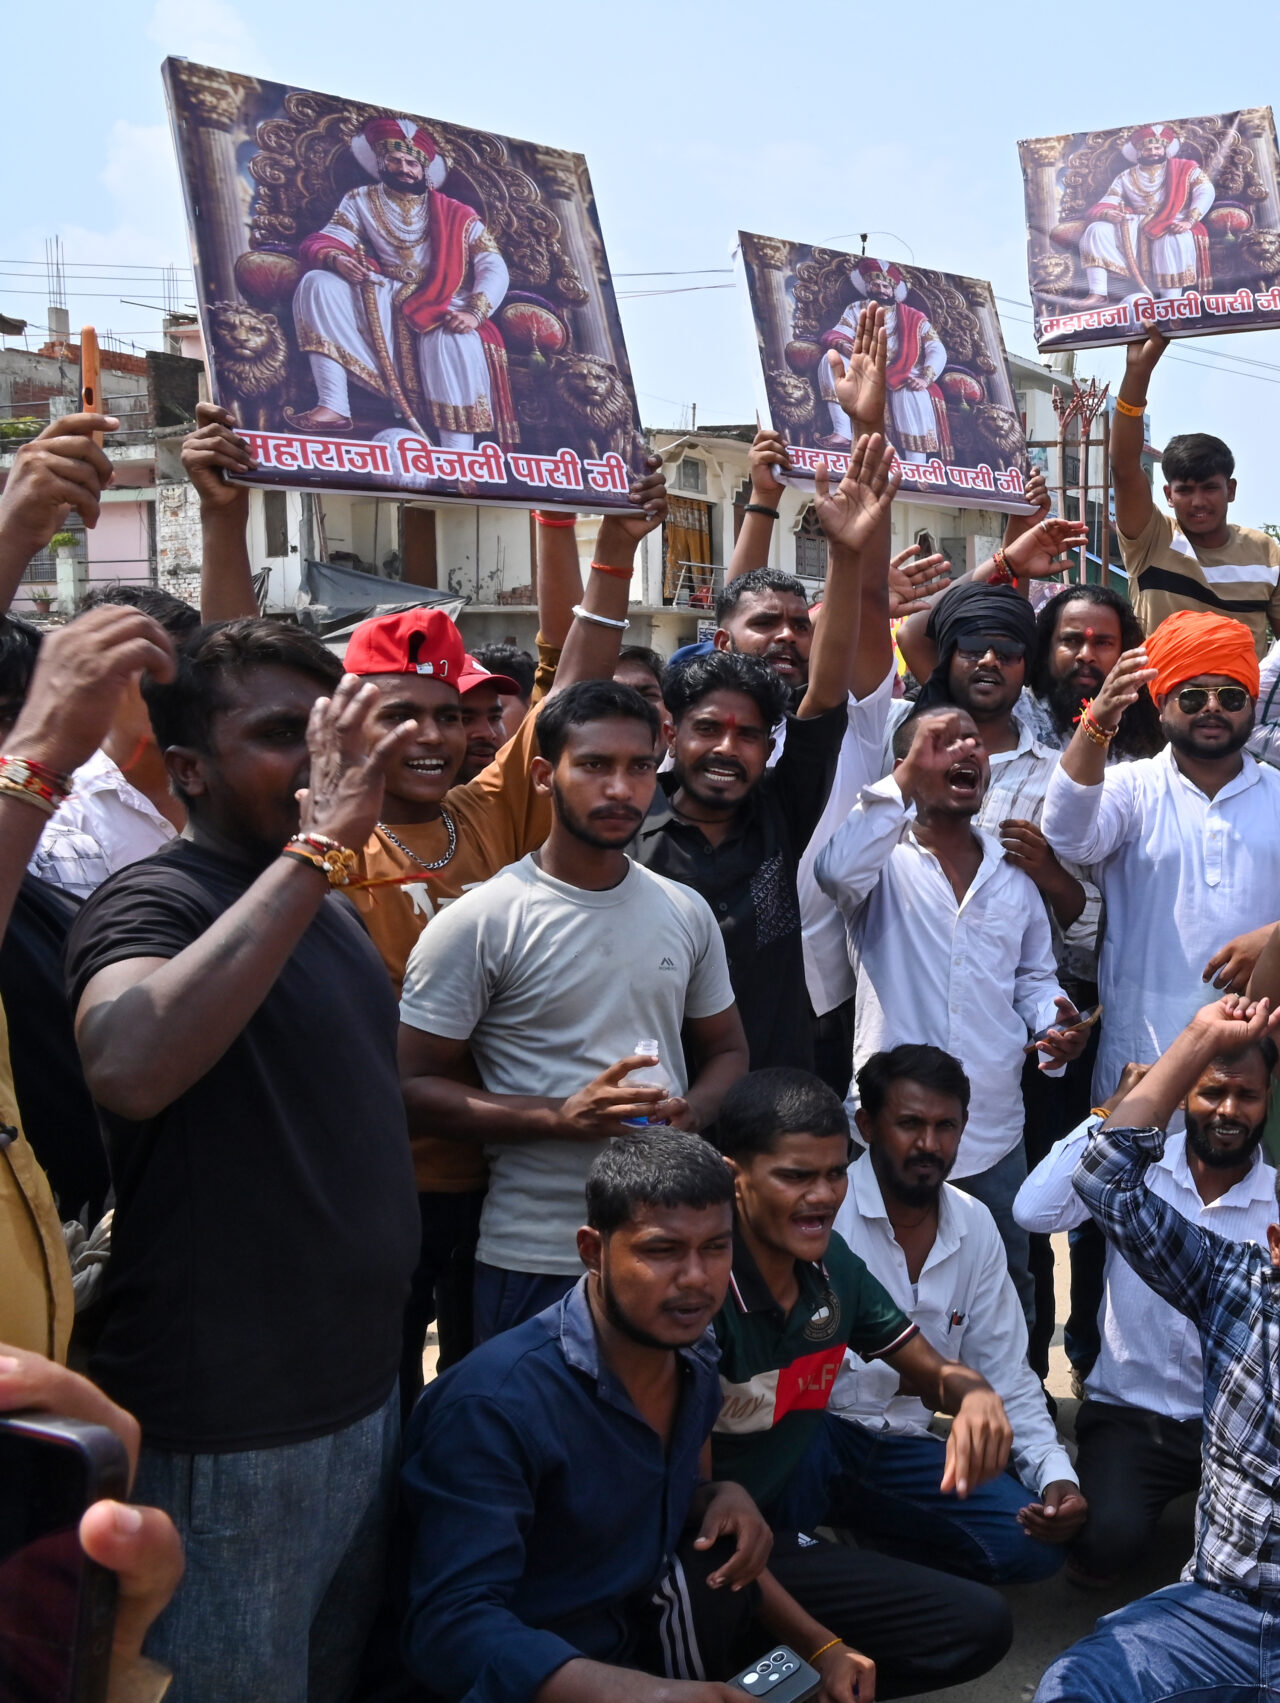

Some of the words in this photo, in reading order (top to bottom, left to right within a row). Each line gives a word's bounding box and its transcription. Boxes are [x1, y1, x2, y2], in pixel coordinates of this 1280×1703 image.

[1040, 304, 1128, 336] महाराजा
[1132, 291, 1201, 323] बिजली
[1204, 288, 1253, 315] पासी
[233, 429, 393, 475] महाराजा
[397, 437, 506, 484] बिजली
[508, 448, 583, 490] पासी
[585, 451, 630, 495] जी
[787, 445, 851, 473] महारा
[946, 463, 995, 491] पासी
[995, 466, 1025, 495] जी
